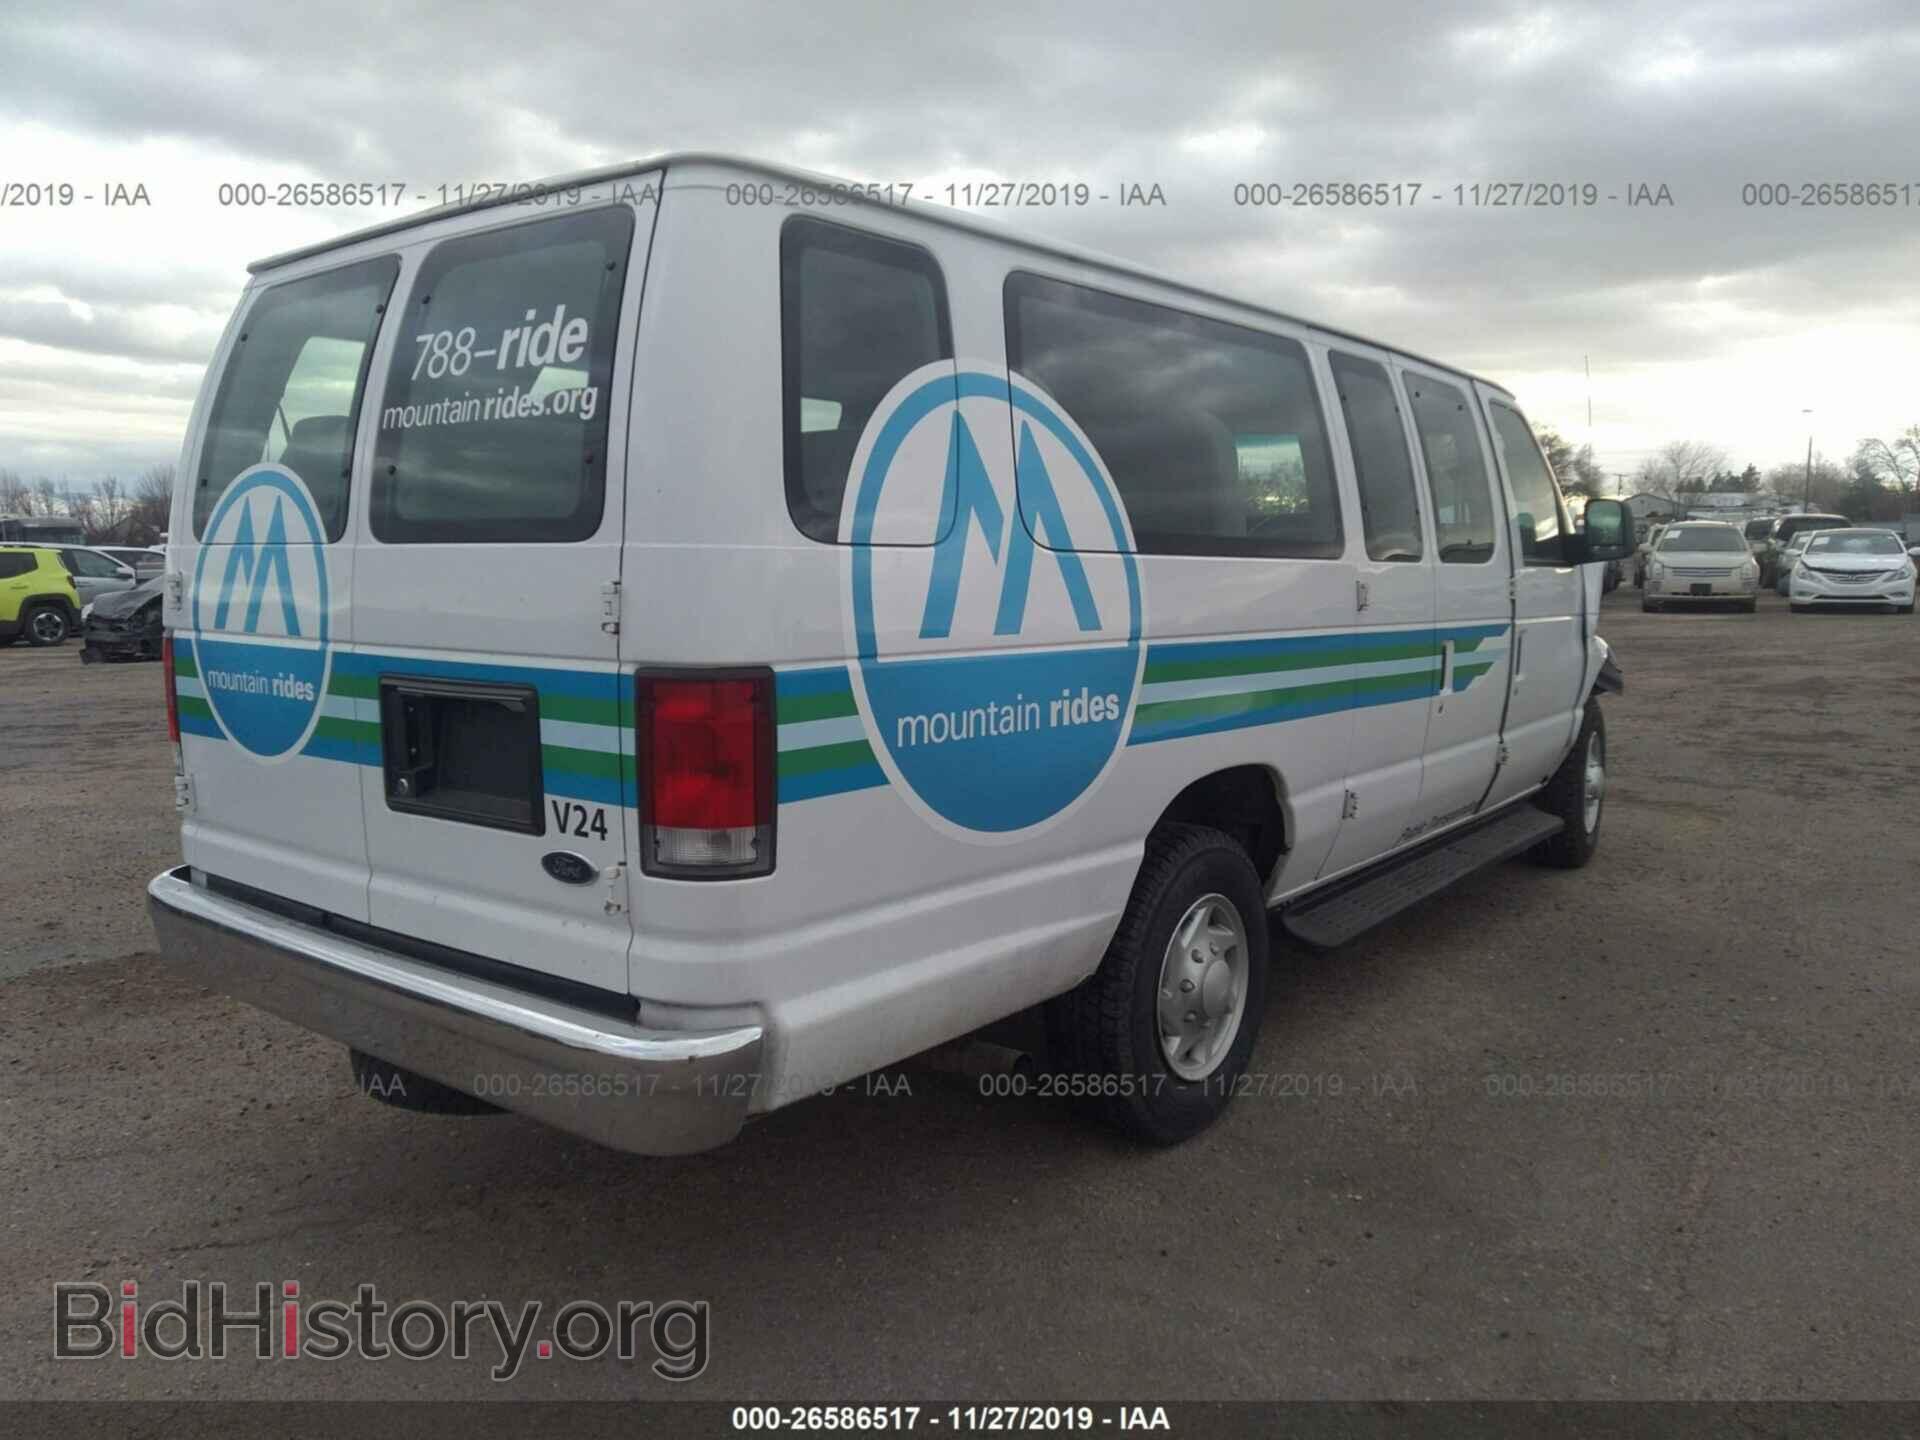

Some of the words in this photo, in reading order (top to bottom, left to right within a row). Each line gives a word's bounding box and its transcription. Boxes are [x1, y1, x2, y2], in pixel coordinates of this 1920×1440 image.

[207, 669, 268, 695] mountain
[272, 674, 315, 701] rides
[897, 693, 1041, 748] mountain
[1049, 687, 1120, 728] rides
[551, 800, 608, 841] V24
